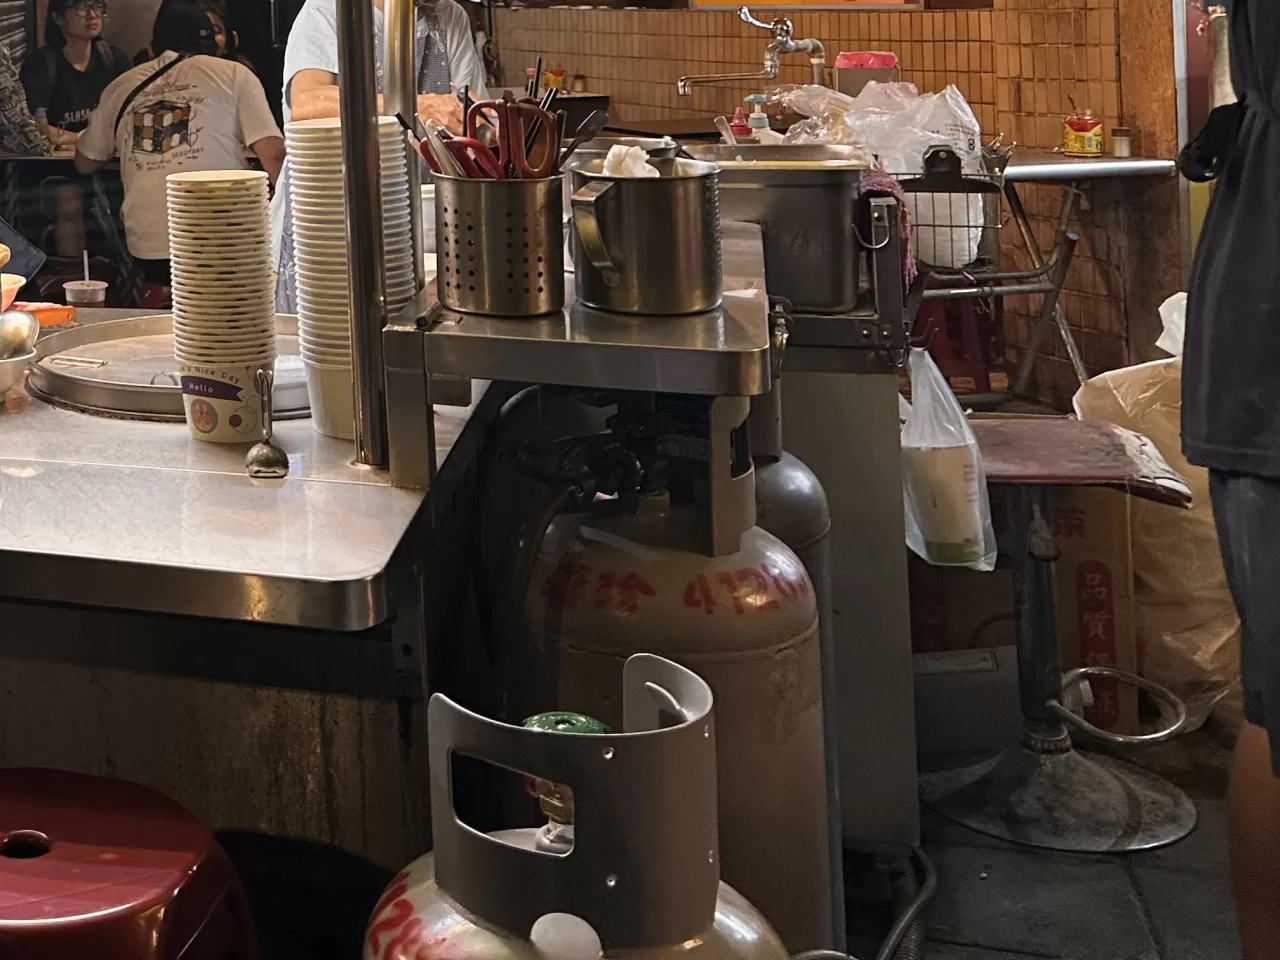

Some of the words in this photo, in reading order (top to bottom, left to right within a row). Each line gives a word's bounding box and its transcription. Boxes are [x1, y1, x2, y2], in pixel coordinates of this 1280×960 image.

[195, 366, 215, 377] Nice
[221, 372, 240, 384] Day
[189, 383, 213, 393] Hello
